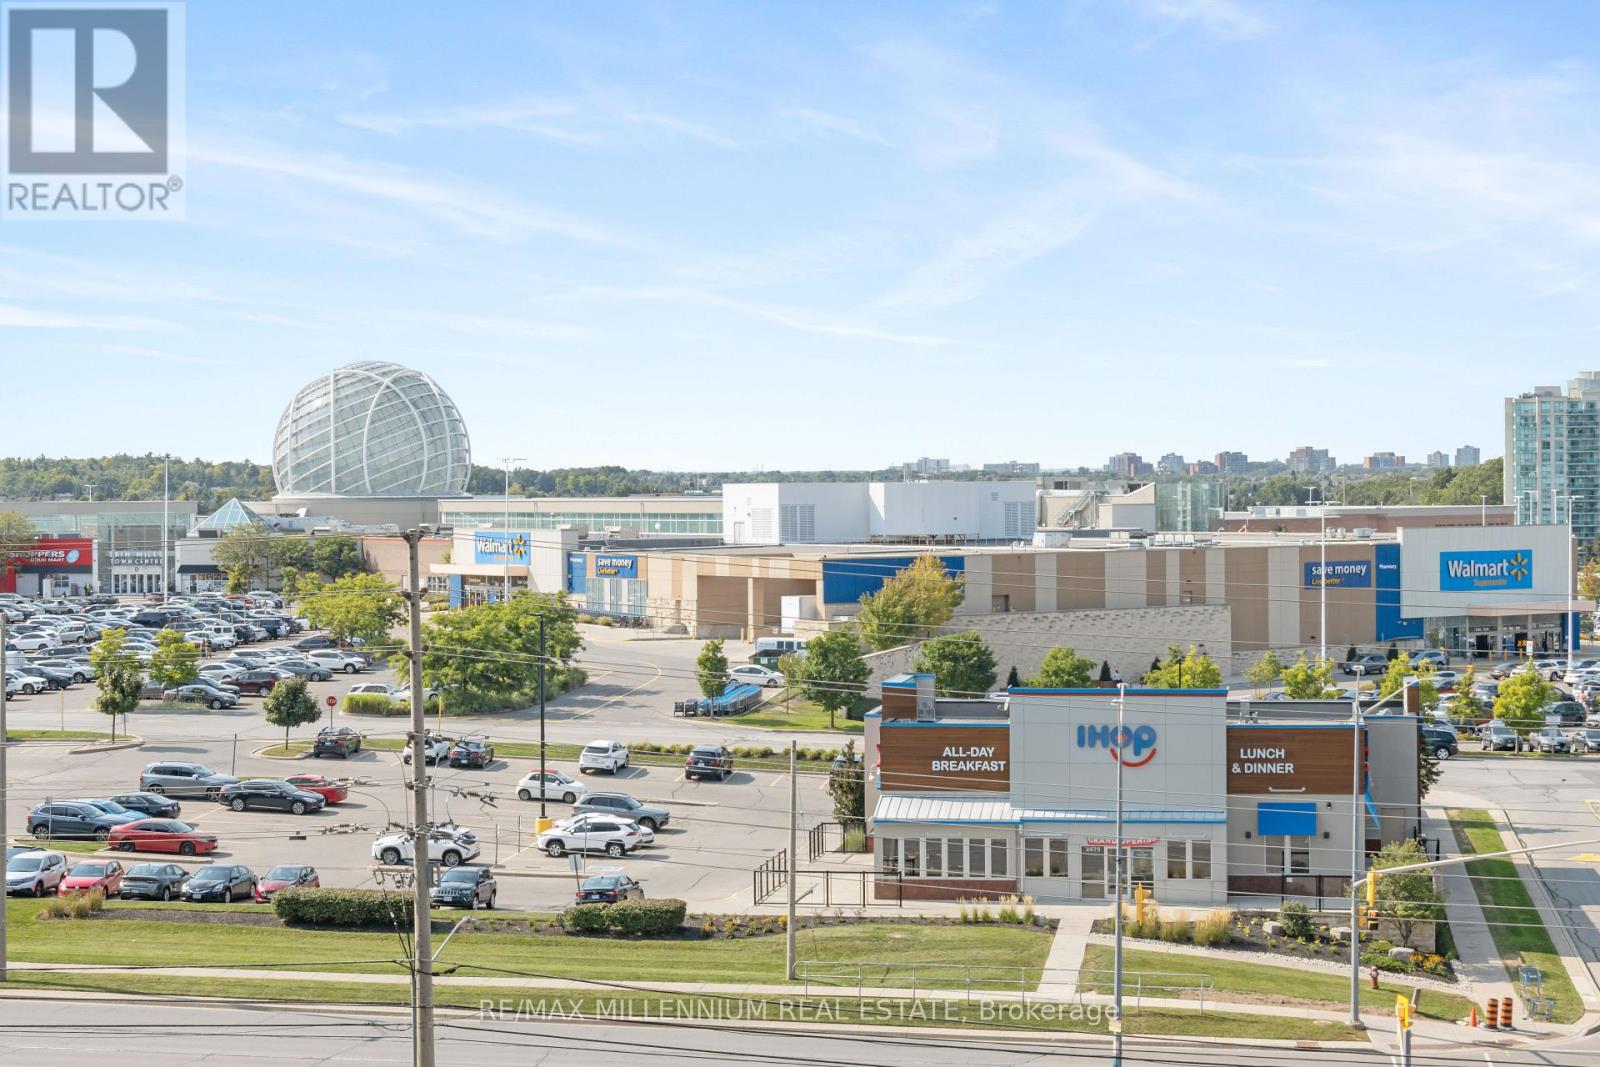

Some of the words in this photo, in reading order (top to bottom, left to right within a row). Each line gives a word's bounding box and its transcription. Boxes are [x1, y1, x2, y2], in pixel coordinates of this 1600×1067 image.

[478, 538, 512, 553] Walmart
[612, 559, 632, 568] money
[1447, 559, 1509, 577] Walmart
[1335, 564, 1366, 576] money
[943, 747, 995, 757] ALL-DAY
[1240, 748, 1285, 758] LUNCH
[932, 761, 1006, 771] BREAKFAST
[1232, 763, 1241, 773] &
[1244, 763, 1294, 773] DINNER
